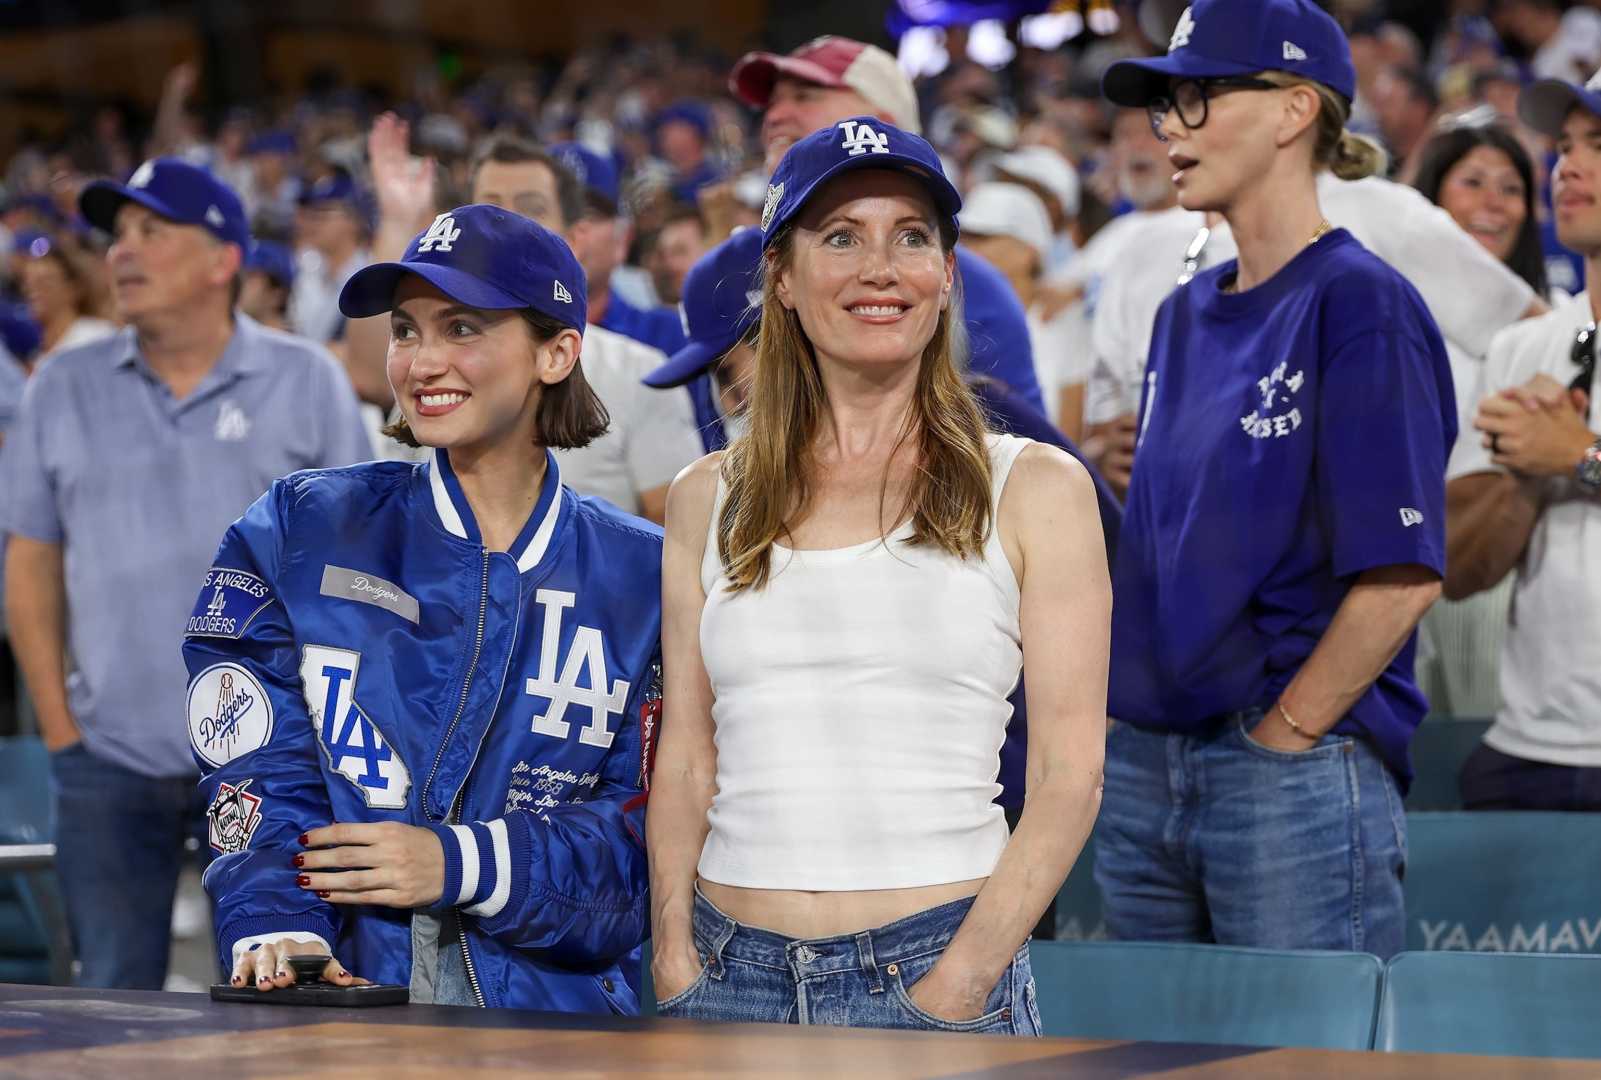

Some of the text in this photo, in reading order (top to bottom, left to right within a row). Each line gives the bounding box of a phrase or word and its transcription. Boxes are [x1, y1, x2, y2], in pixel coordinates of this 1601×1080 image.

[839, 121, 889, 156] LA
[418, 212, 461, 253] LA
[213, 572, 269, 598] ANGELES
[351, 576, 399, 602] Dodgers
[207, 586, 227, 616] LA
[188, 616, 236, 634] DODGERS
[525, 588, 631, 749] LA
[200, 688, 253, 748] Dodgers
[320, 665, 393, 790] LA
[531, 765, 578, 784] Angeles
[532, 778, 564, 796] 1958
